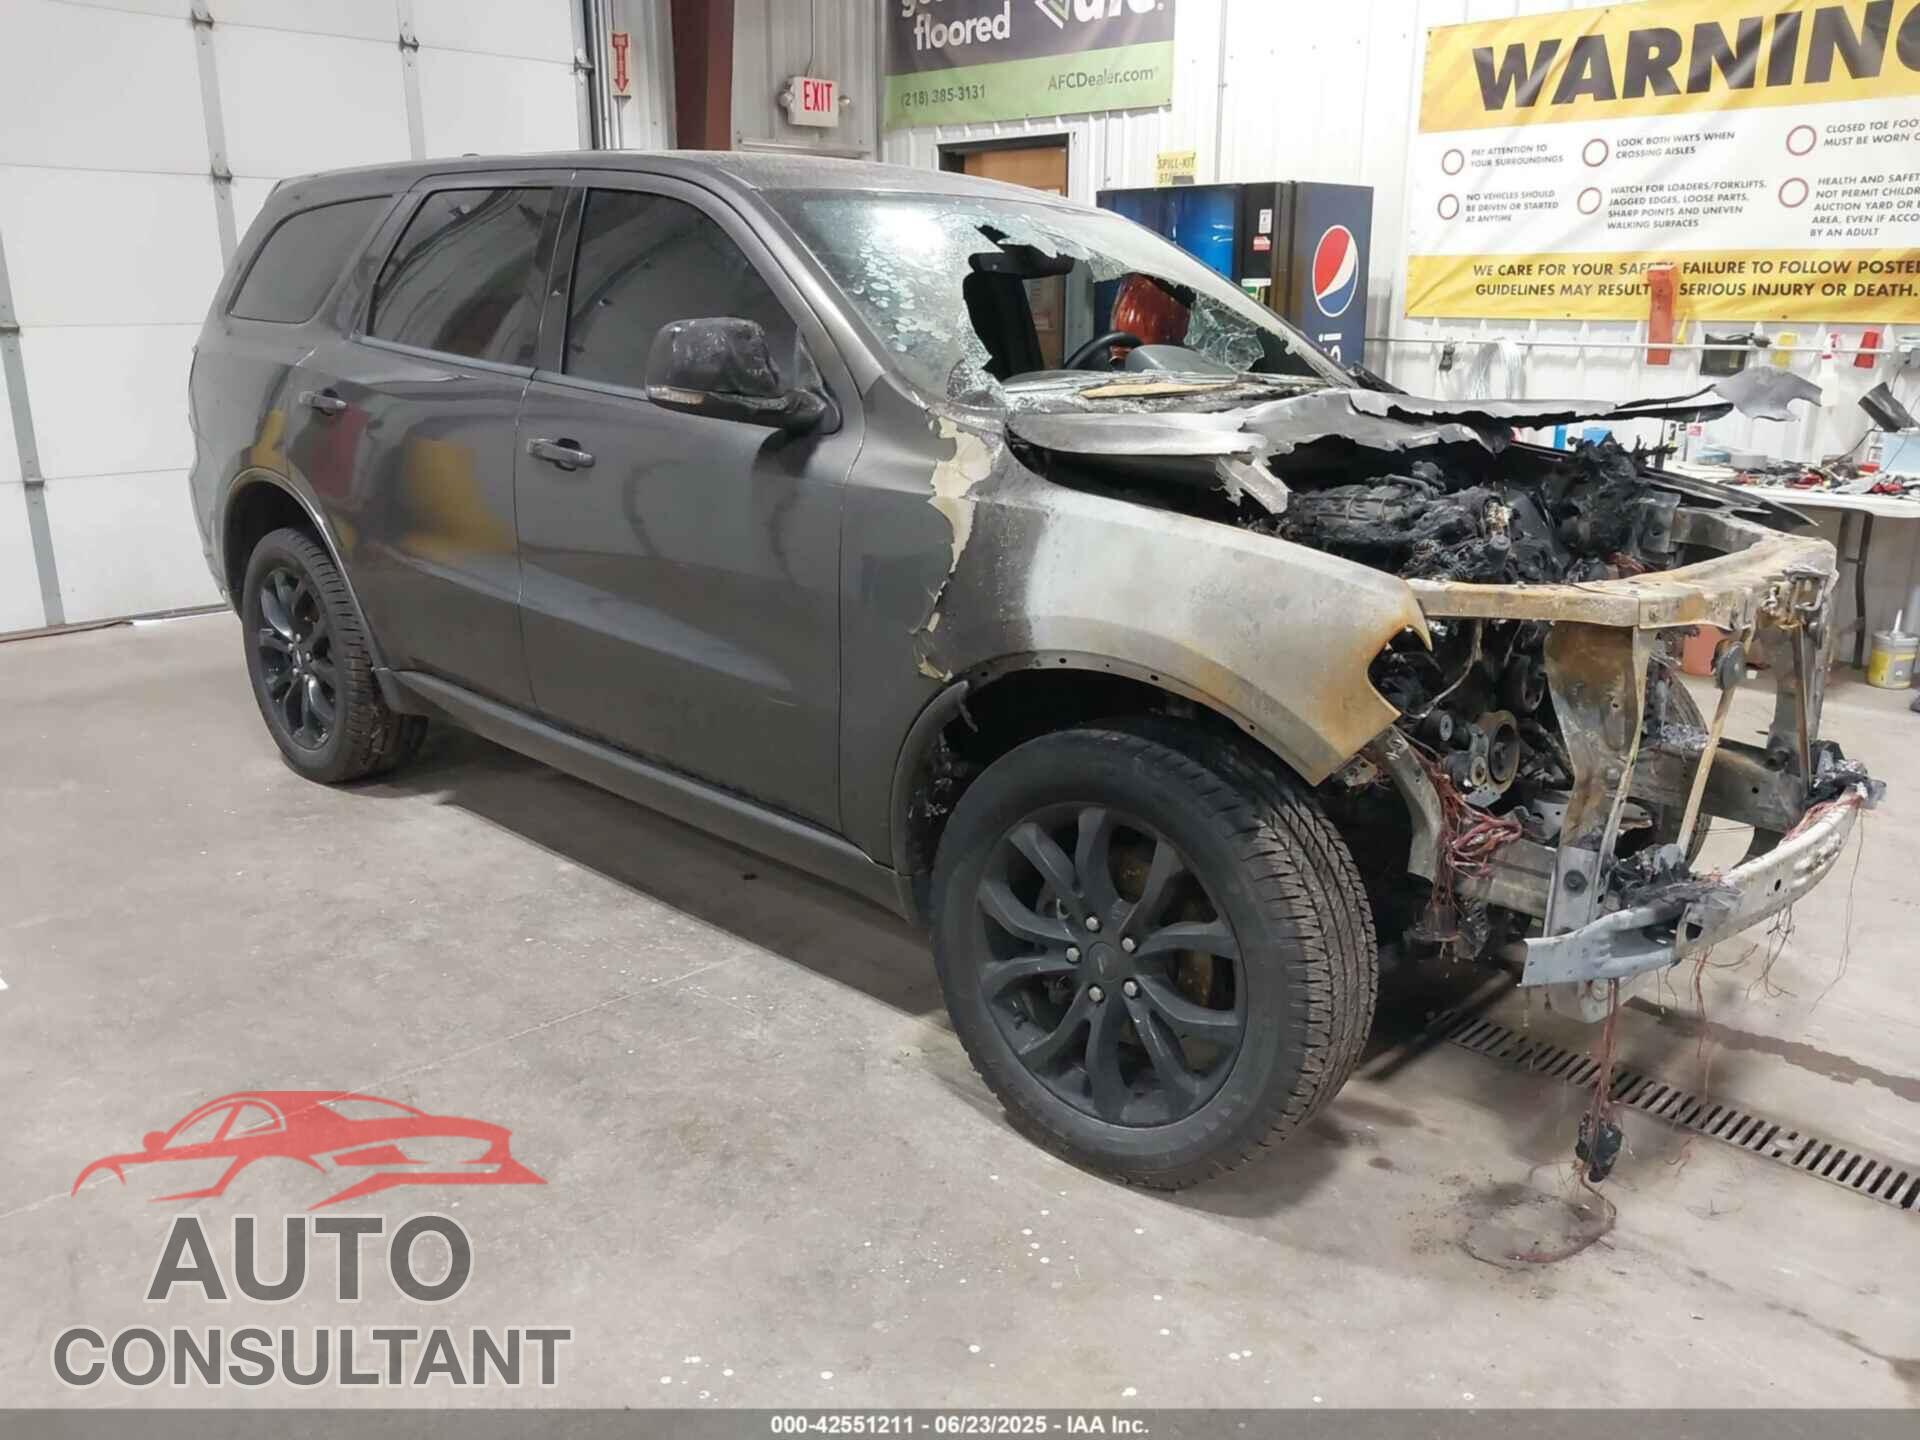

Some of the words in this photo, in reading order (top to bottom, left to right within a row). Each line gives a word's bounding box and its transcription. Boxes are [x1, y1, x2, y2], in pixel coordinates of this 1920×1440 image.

[914, 1, 1010, 51] floored
[1048, 68, 1153, 91] AFCDealer.com
[803, 80, 832, 112] EXIT
[901, 90, 928, 106] (218)
[932, 84, 985, 103] 385-3131
[1826, 123, 1866, 134] CLOSED
[1869, 120, 1889, 130] TOE
[1617, 138, 1643, 147] LOOK
[1646, 136, 1671, 145] BOTH
[1673, 133, 1701, 142] WAYS
[1704, 131, 1736, 141] WHEN
[1824, 136, 1854, 146] MUST
[1856, 135, 1868, 144] BE
[1872, 132, 1910, 143] WORN
[1488, 144, 1534, 155] ATTENTION
[1536, 144, 1547, 152] TO
[1616, 149, 1662, 159] CROSSING
[1664, 146, 1697, 155] AISLES
[1471, 158, 1492, 167] YOUR
[1495, 155, 1564, 167] SURROUNDINGS
[1817, 176, 1857, 185] HEALTH
[1860, 174, 1884, 184] AND
[1611, 185, 1643, 194] WATCH
[1645, 184, 1664, 193] FOR
[1816, 189, 1838, 199] NOT
[1841, 188, 1878, 198] PERMIT
[1467, 193, 1481, 201] NO
[1484, 191, 1519, 200] VEHICLES
[1521, 190, 1555, 199] SHOULD
[1609, 197, 1646, 206] JAGGED
[1683, 194, 1715, 203] LOOSE
[1466, 203, 1476, 212] BE
[1478, 203, 1507, 212] DRIVEN
[1509, 202, 1521, 210] OR
[1524, 201, 1559, 210] STARTED
[1608, 209, 1639, 218] SHARP
[1641, 207, 1675, 216] POINTS
[1678, 207, 1699, 215] AND
[1702, 205, 1743, 215] UNEVEN
[1814, 202, 1861, 212] AUCTION
[1865, 200, 1893, 210] YARD
[1896, 200, 1913, 209] OR
[1465, 215, 1476, 223] AT
[1478, 214, 1512, 223] ANYTIME
[1607, 220, 1650, 230] WALKING
[1653, 219, 1699, 228] SURFACES
[1846, 214, 1873, 224] EVEN
[1876, 214, 1886, 223] IF
[1810, 228, 1823, 237] BY
[1826, 228, 1842, 237] AN
[1846, 227, 1879, 236] ADULT
[1473, 264, 1494, 276] WE
[1498, 263, 1533, 276] CARE
[1537, 263, 1566, 276] FOR
[1572, 262, 1613, 276] YOUR
[1619, 262, 1674, 275] SAF
[1682, 261, 1746, 275] FAILURE
[1751, 260, 1773, 274] TO
[1778, 260, 1852, 274] FOLLOW
[1475, 283, 1555, 296] GUIDELINES
[1559, 283, 1592, 296] MAY
[1597, 283, 1651, 296] RESULT
[1679, 283, 1746, 296] SERIOUS
[1752, 283, 1815, 296] INJURY
[1821, 283, 1847, 296] OR
[1853, 283, 1919, 297] DEATH.
